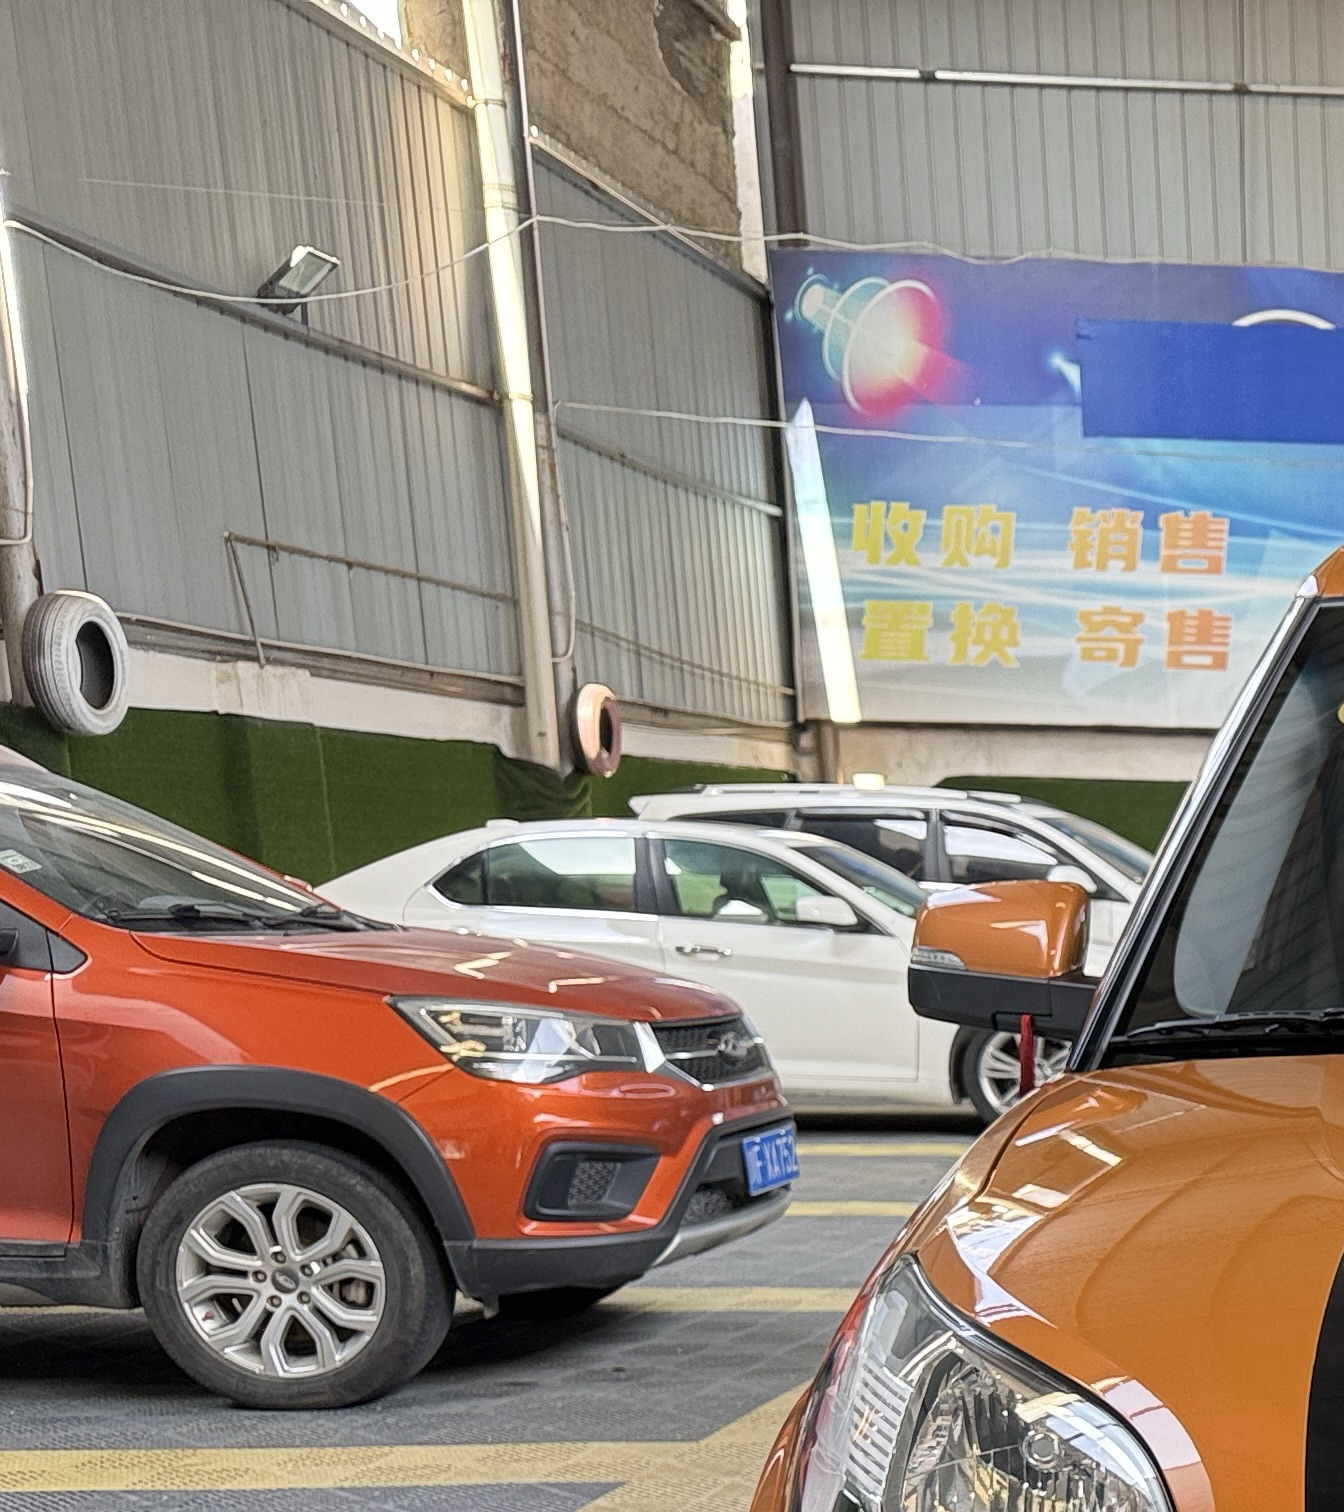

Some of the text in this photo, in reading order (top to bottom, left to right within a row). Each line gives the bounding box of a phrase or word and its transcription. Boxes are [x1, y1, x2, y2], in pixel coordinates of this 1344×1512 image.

[852, 501, 1231, 576] 收购 销售
[862, 600, 1234, 672] 置换 寄售
